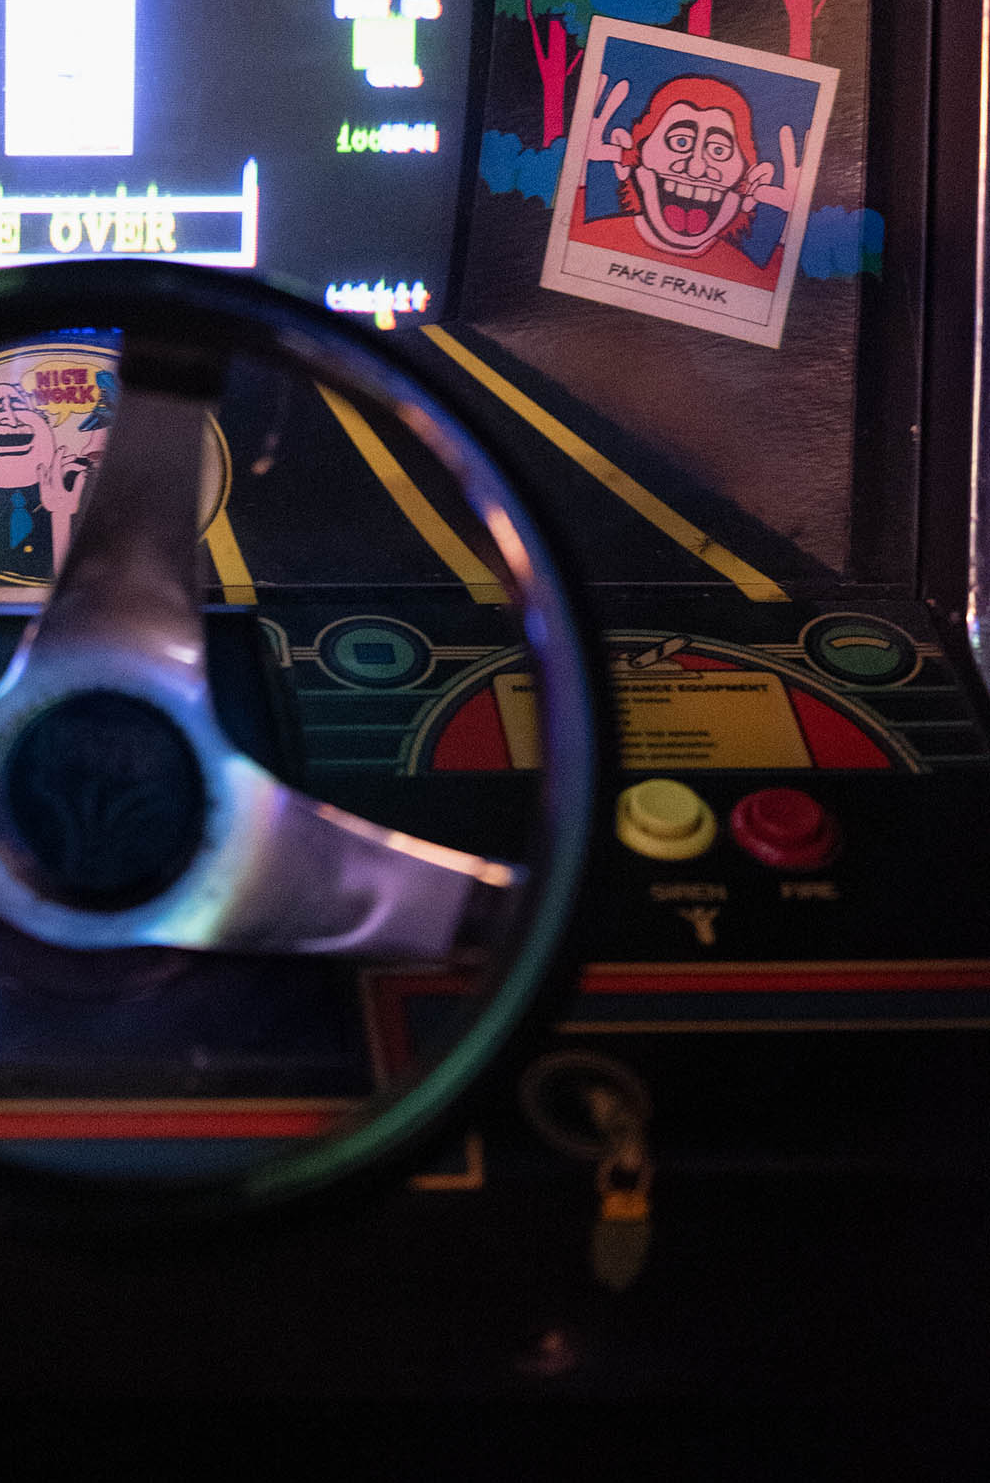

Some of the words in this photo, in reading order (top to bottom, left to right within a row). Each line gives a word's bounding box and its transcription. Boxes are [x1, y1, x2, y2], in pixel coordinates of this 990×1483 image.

[49, 207, 177, 253] OVER
[608, 263, 658, 285] FAKE
[660, 276, 727, 304] FRANK
[35, 368, 88, 389] NICE
[33, 385, 95, 406] WORK
